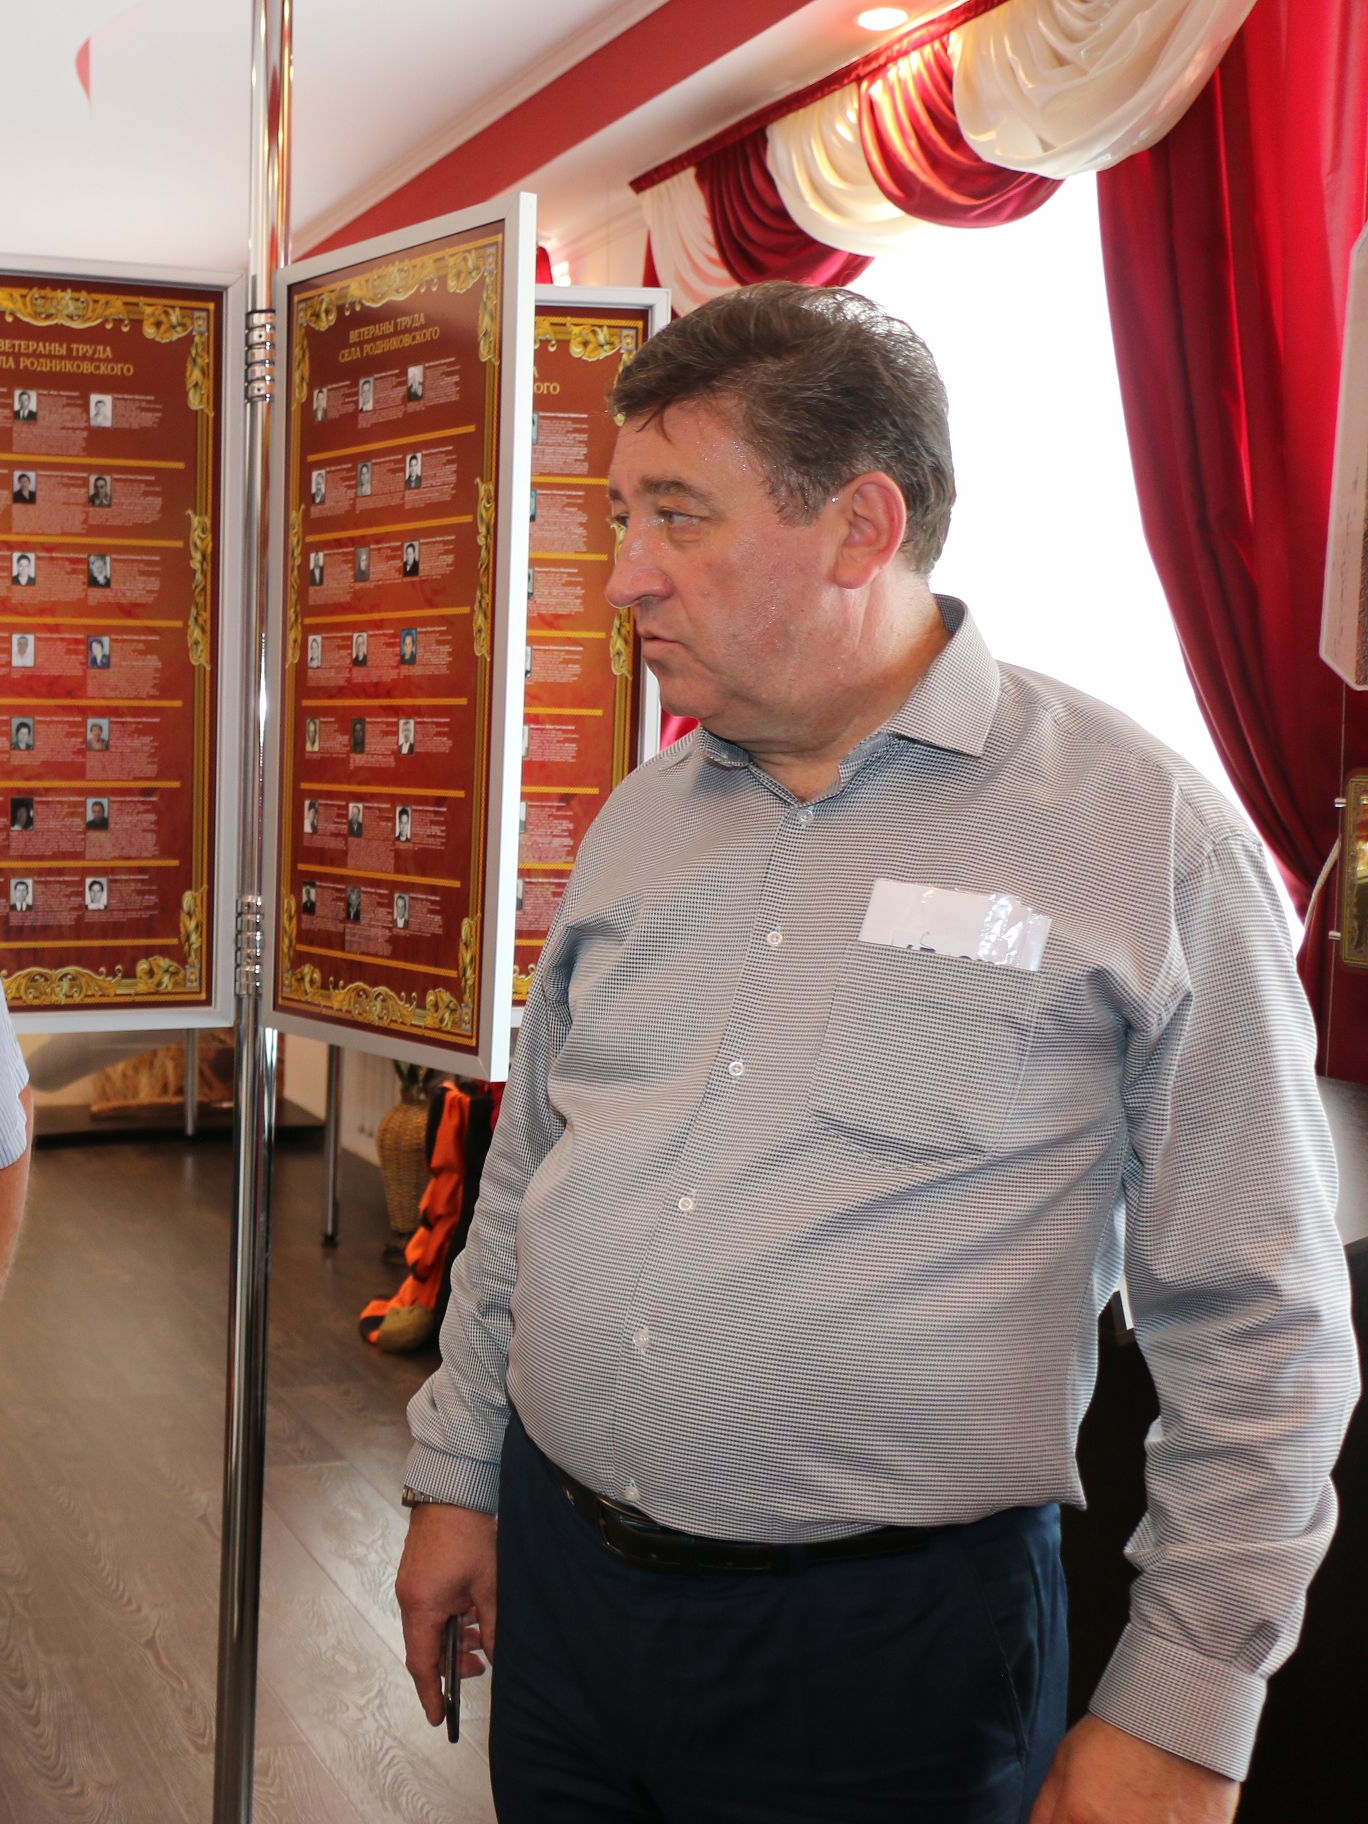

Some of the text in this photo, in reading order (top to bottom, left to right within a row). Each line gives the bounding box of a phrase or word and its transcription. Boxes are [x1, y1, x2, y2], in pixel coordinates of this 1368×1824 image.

[349, 313, 425, 343] ВЕТЕРАНЫ ТРУДА
[71, 343, 112, 358] ТРУДА
[339, 326, 440, 363] СЕЛА РОДНИКОВСКОГО
[19, 357, 134, 376] РОДНИКОВСКОГО
